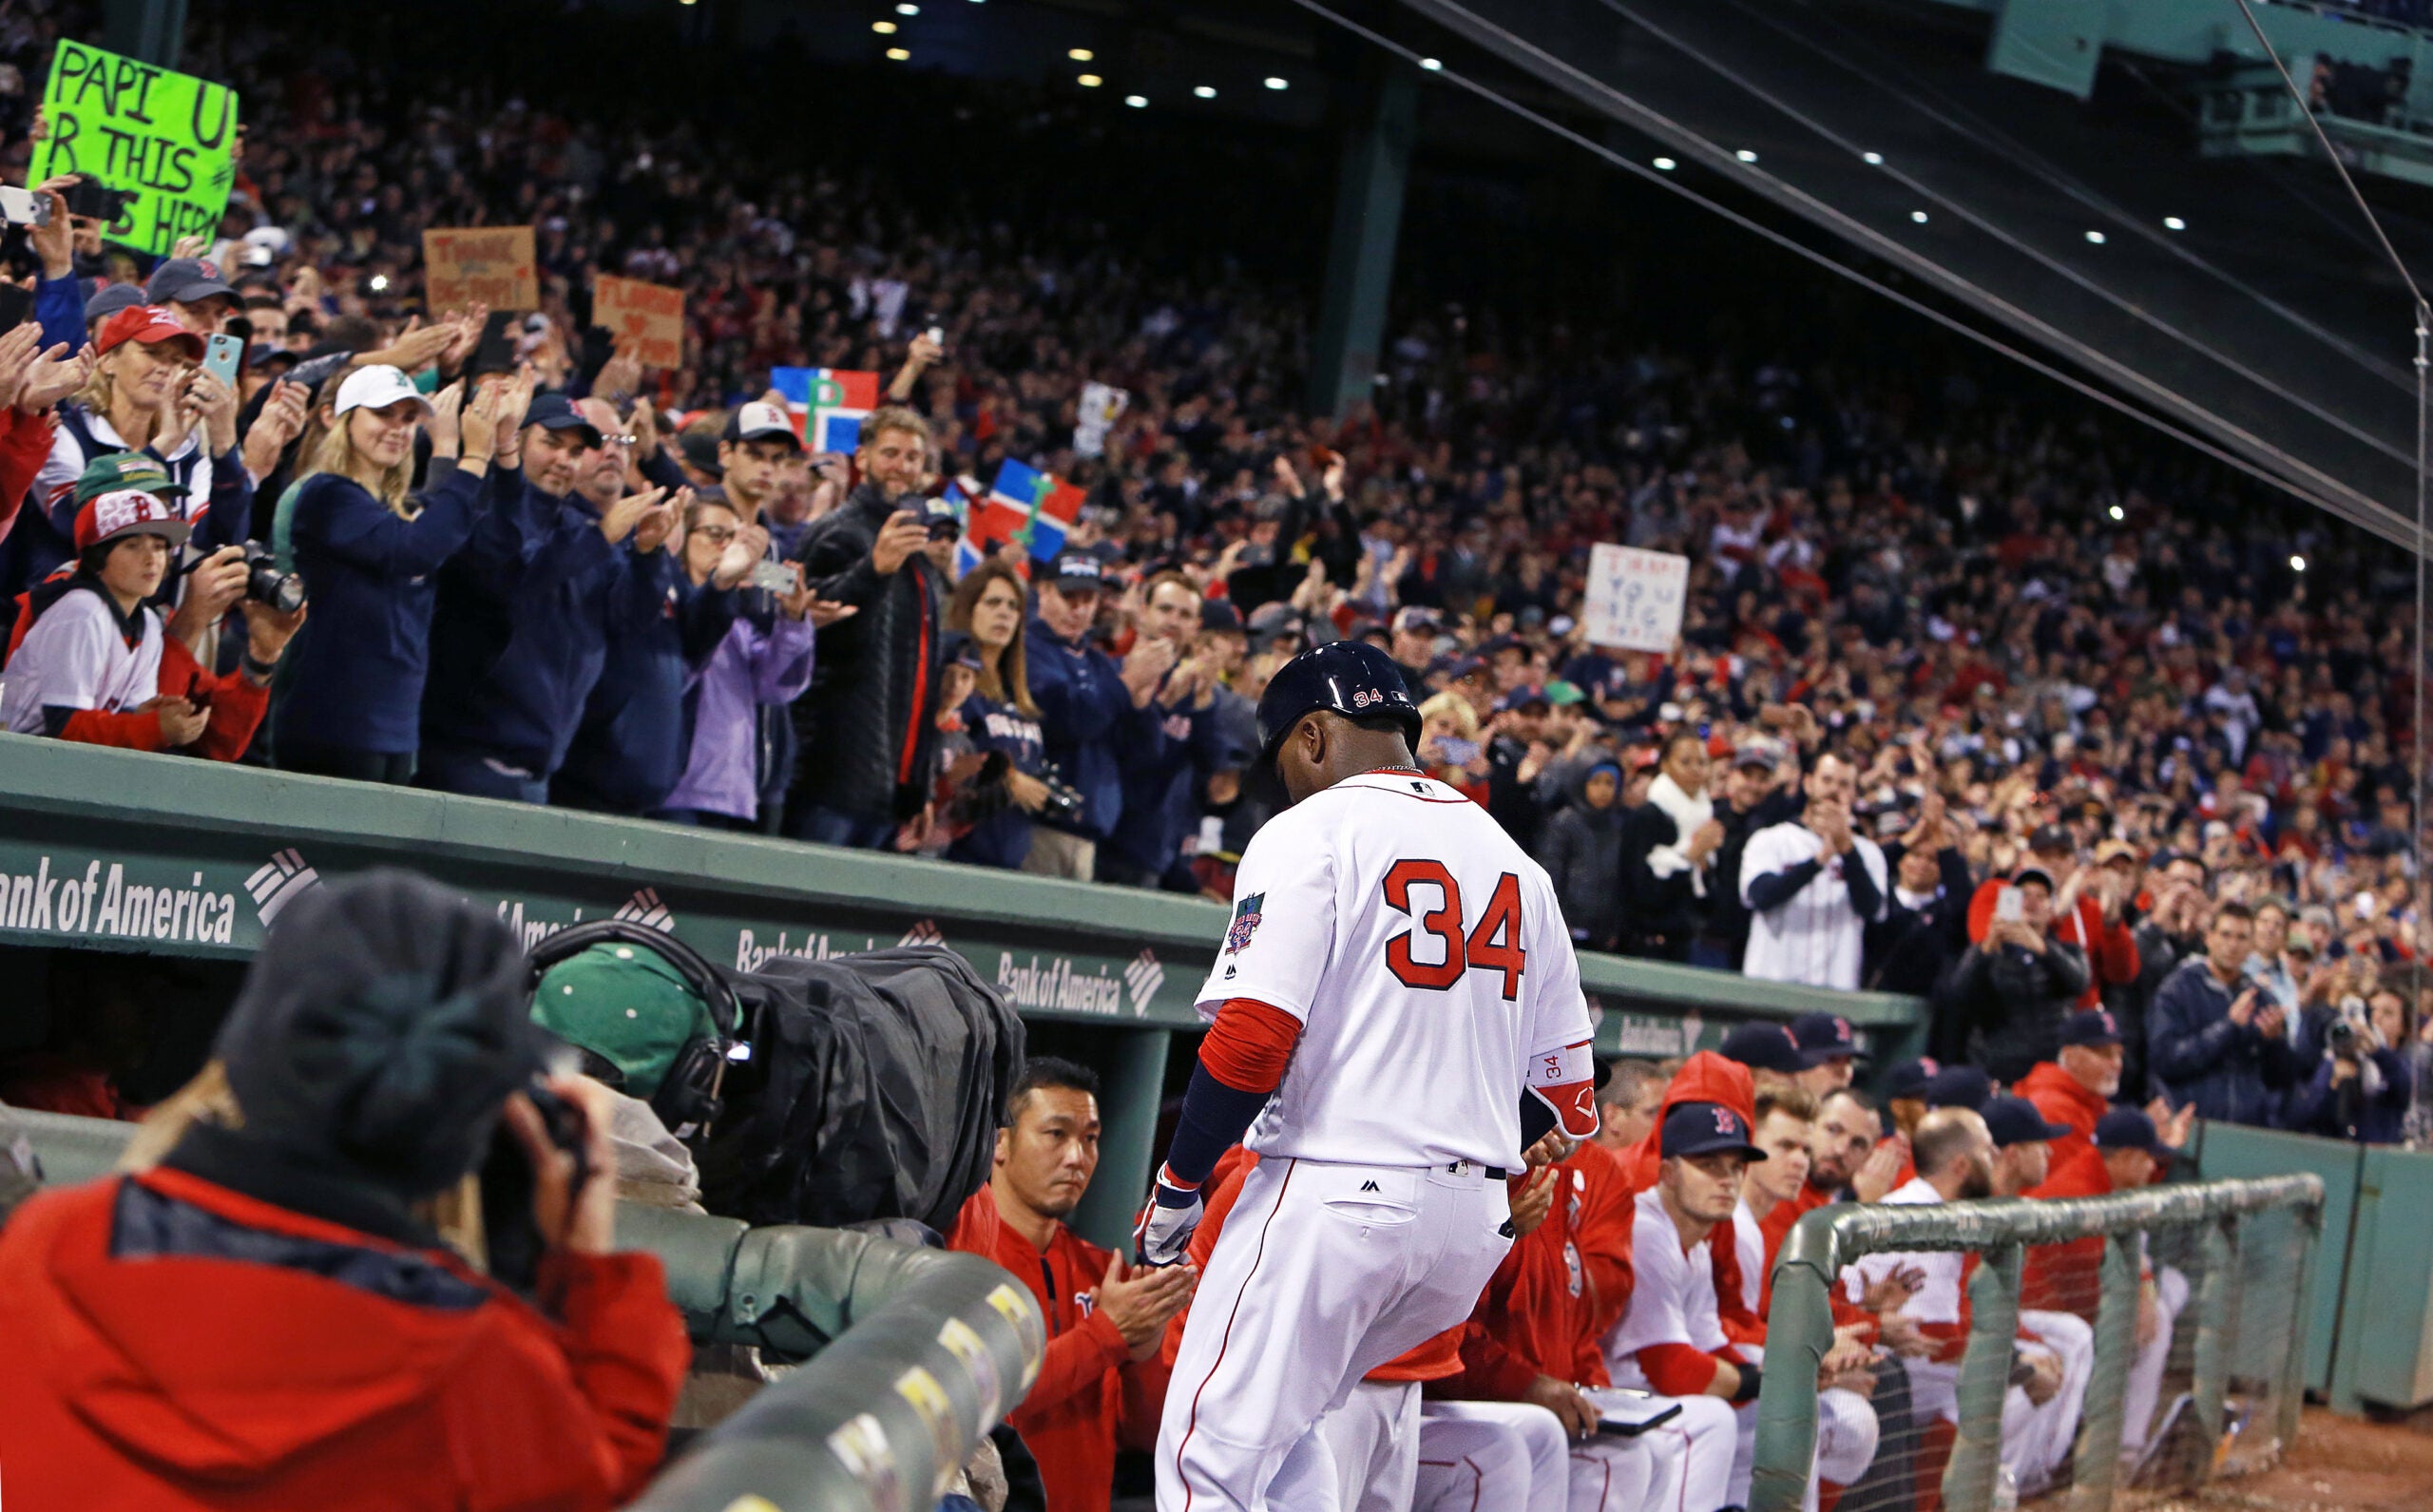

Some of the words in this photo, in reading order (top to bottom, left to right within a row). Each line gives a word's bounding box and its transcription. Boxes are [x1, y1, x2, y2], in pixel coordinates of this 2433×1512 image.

[55, 46, 162, 124] PAPI
[192, 81, 232, 150] U
[45, 112, 79, 180] R
[99, 125, 196, 193] THIS
[804, 377, 845, 444] P
[129, 495, 152, 522] B
[1353, 688, 1383, 708] 34
[58, 859, 100, 932] of
[95, 863, 236, 944] America
[1234, 922, 1253, 943] 34
[1382, 859, 1526, 1002] 34
[998, 951, 1041, 1006] Bank
[1039, 957, 1061, 1008] of
[1056, 959, 1121, 1015] America
[1543, 1055, 1561, 1079] 34
[1712, 1107, 1735, 1134] B
